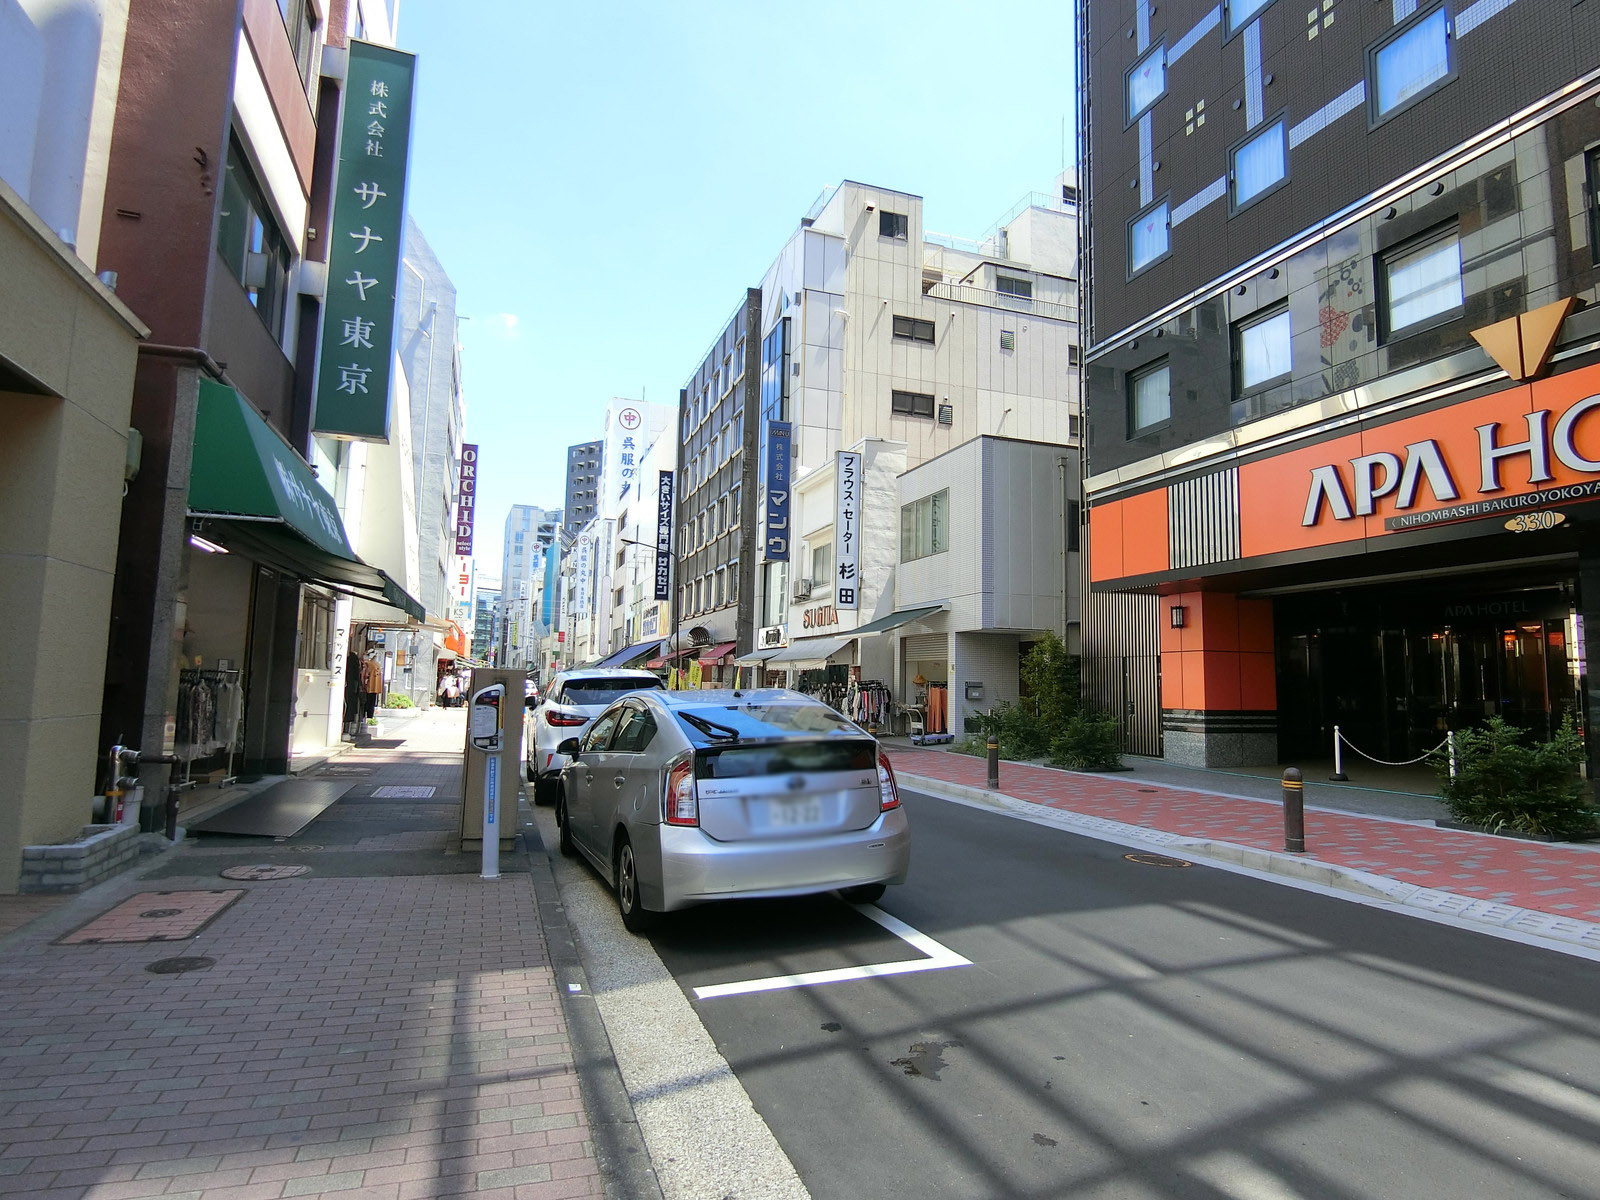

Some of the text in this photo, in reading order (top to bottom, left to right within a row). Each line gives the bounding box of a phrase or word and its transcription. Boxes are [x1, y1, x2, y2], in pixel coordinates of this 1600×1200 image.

[364, 80, 389, 158] 株式会社
[336, 181, 387, 395] サナヤ東京
[775, 443, 784, 481] 株式会社
[1301, 438, 1460, 527] APA
[459, 450, 477, 537] ORCHID
[842, 456, 855, 554] ブラウス・セーター
[768, 489, 788, 553] マンウ
[1514, 510, 1556, 533] 330
[657, 556, 669, 595] サカゼン
[839, 562, 855, 604] 杉田
[453, 608, 464, 616] KS
[1444, 600, 1529, 617] APA HOTEL
[334, 628, 345, 675] マックス
